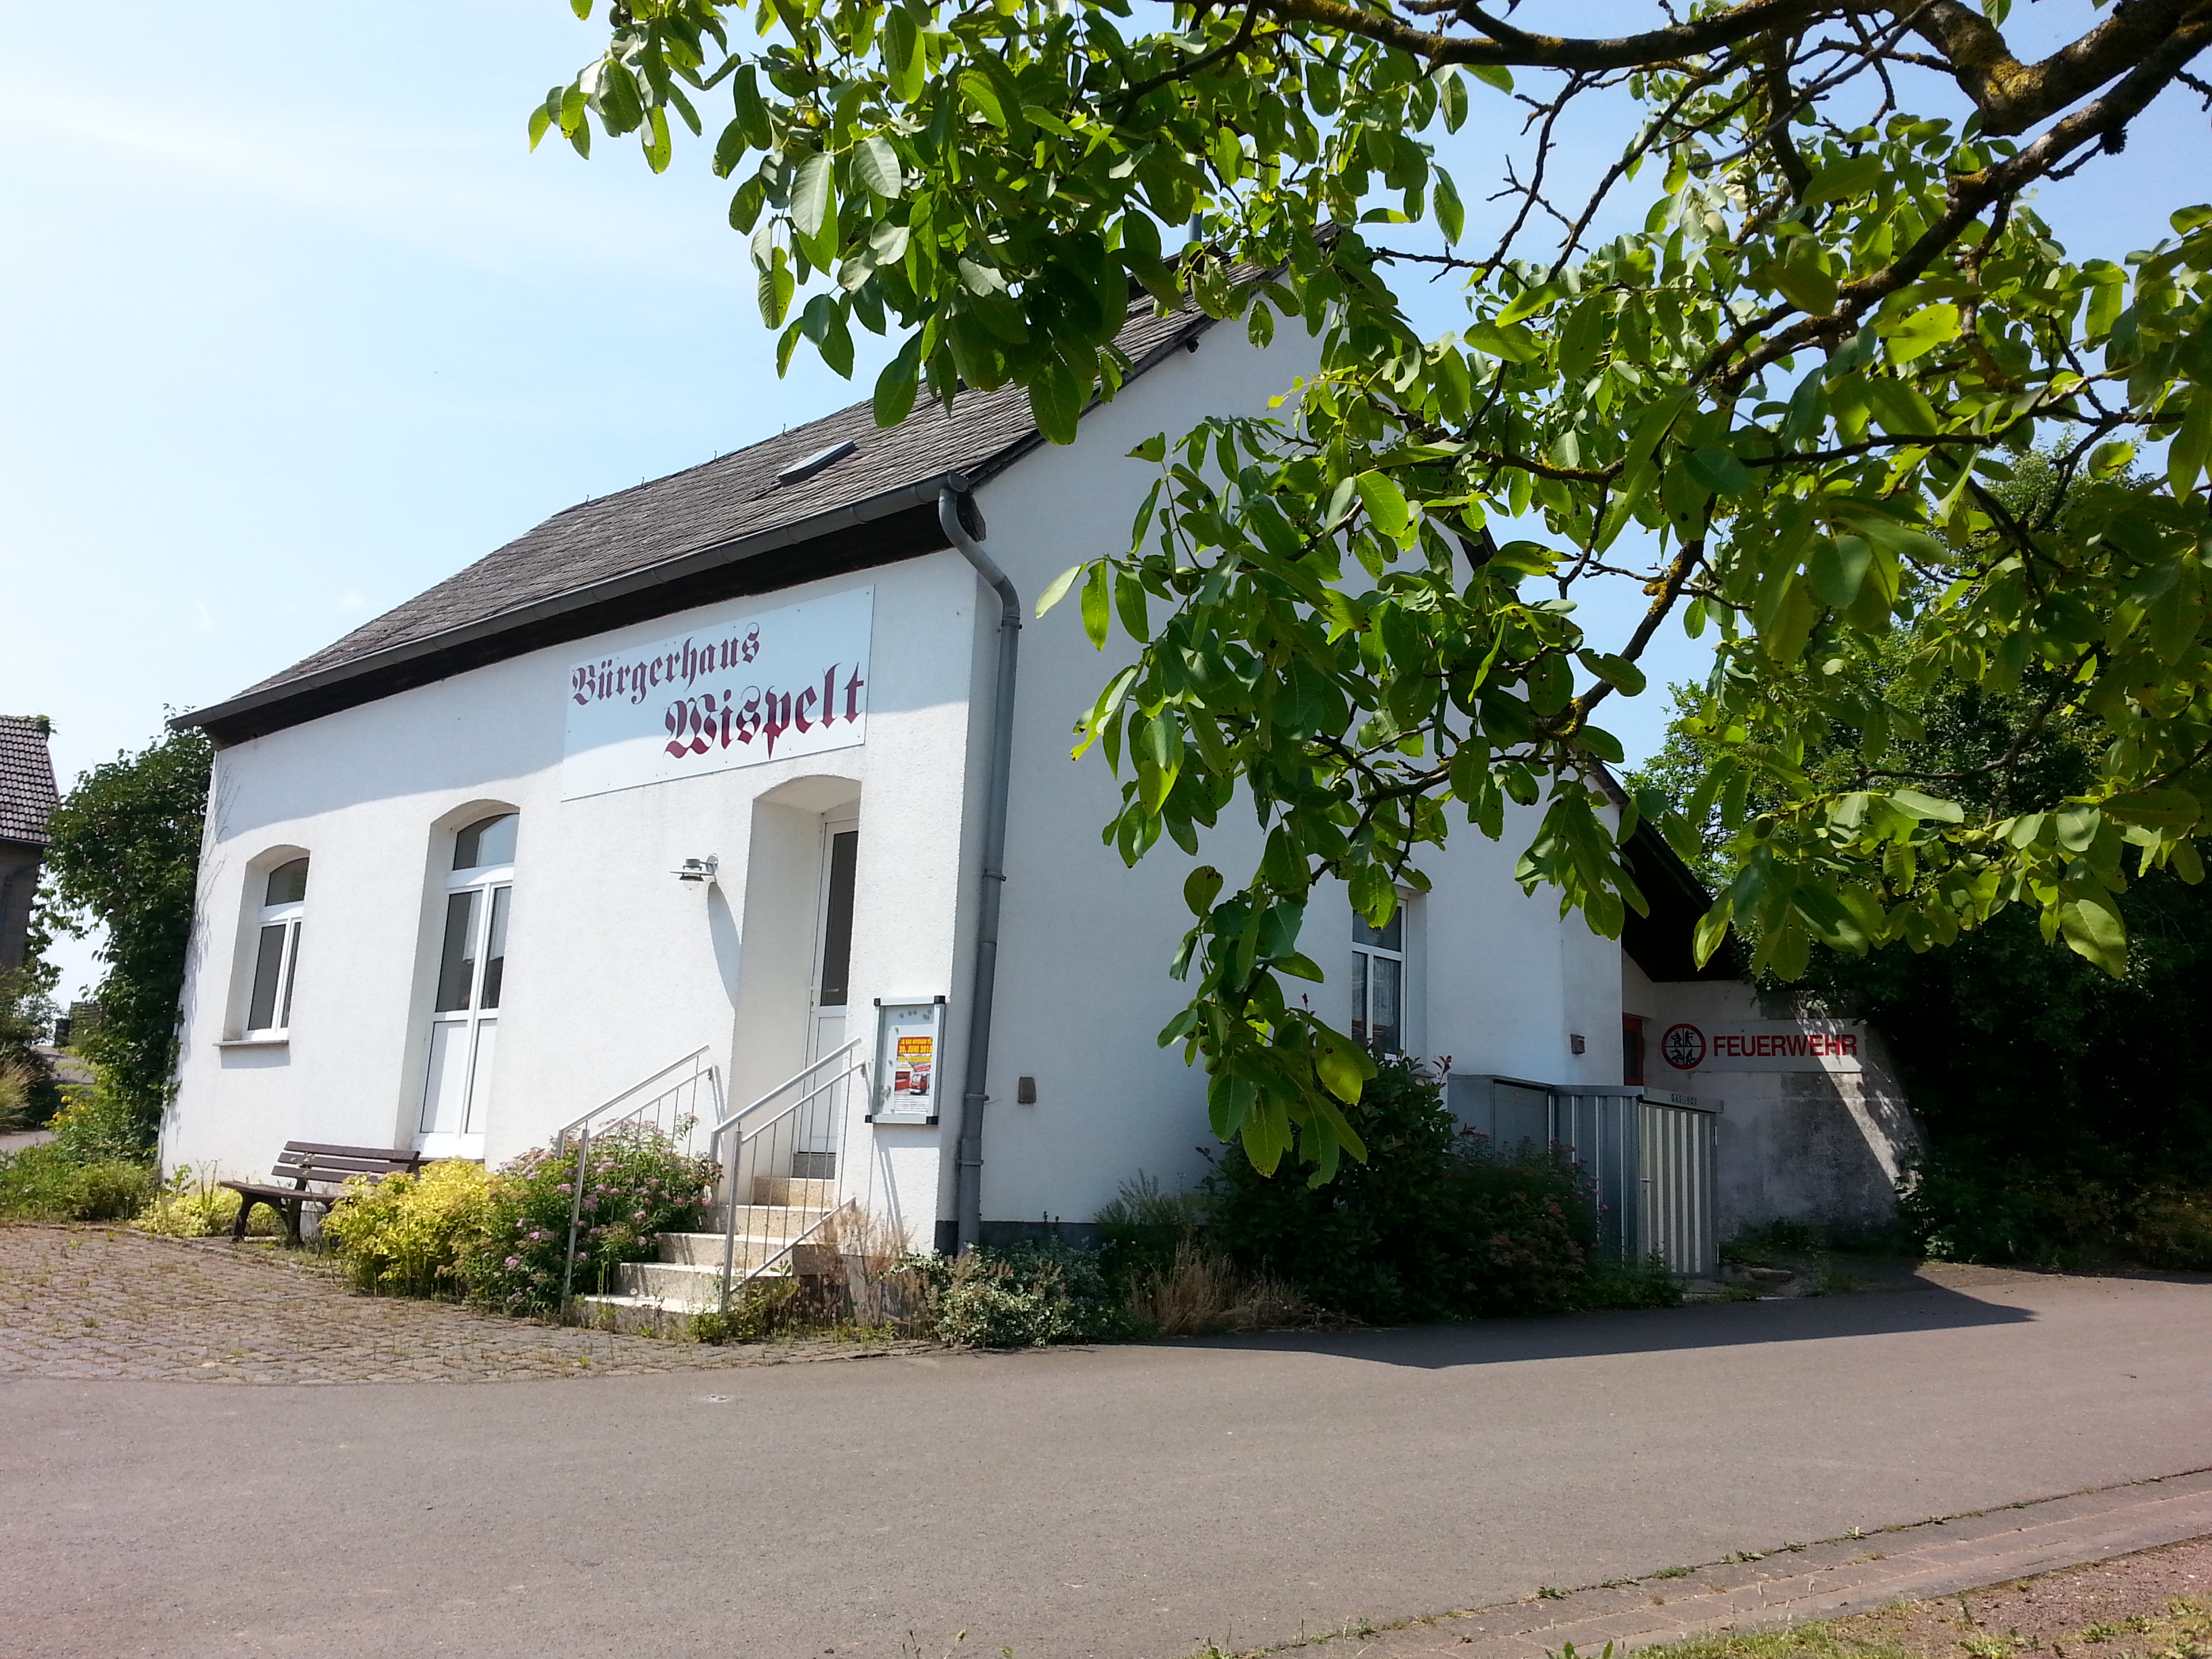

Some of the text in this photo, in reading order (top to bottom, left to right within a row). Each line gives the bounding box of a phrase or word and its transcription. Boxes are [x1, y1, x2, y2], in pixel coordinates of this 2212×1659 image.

[572, 622, 760, 705] Bürgerhaus
[663, 661, 864, 760] Wispelt
[907, 1045, 920, 1053] JUNI
[1713, 1033, 1858, 1057] FEUERWEHR
[1671, 1092, 1681, 1103] GAS
